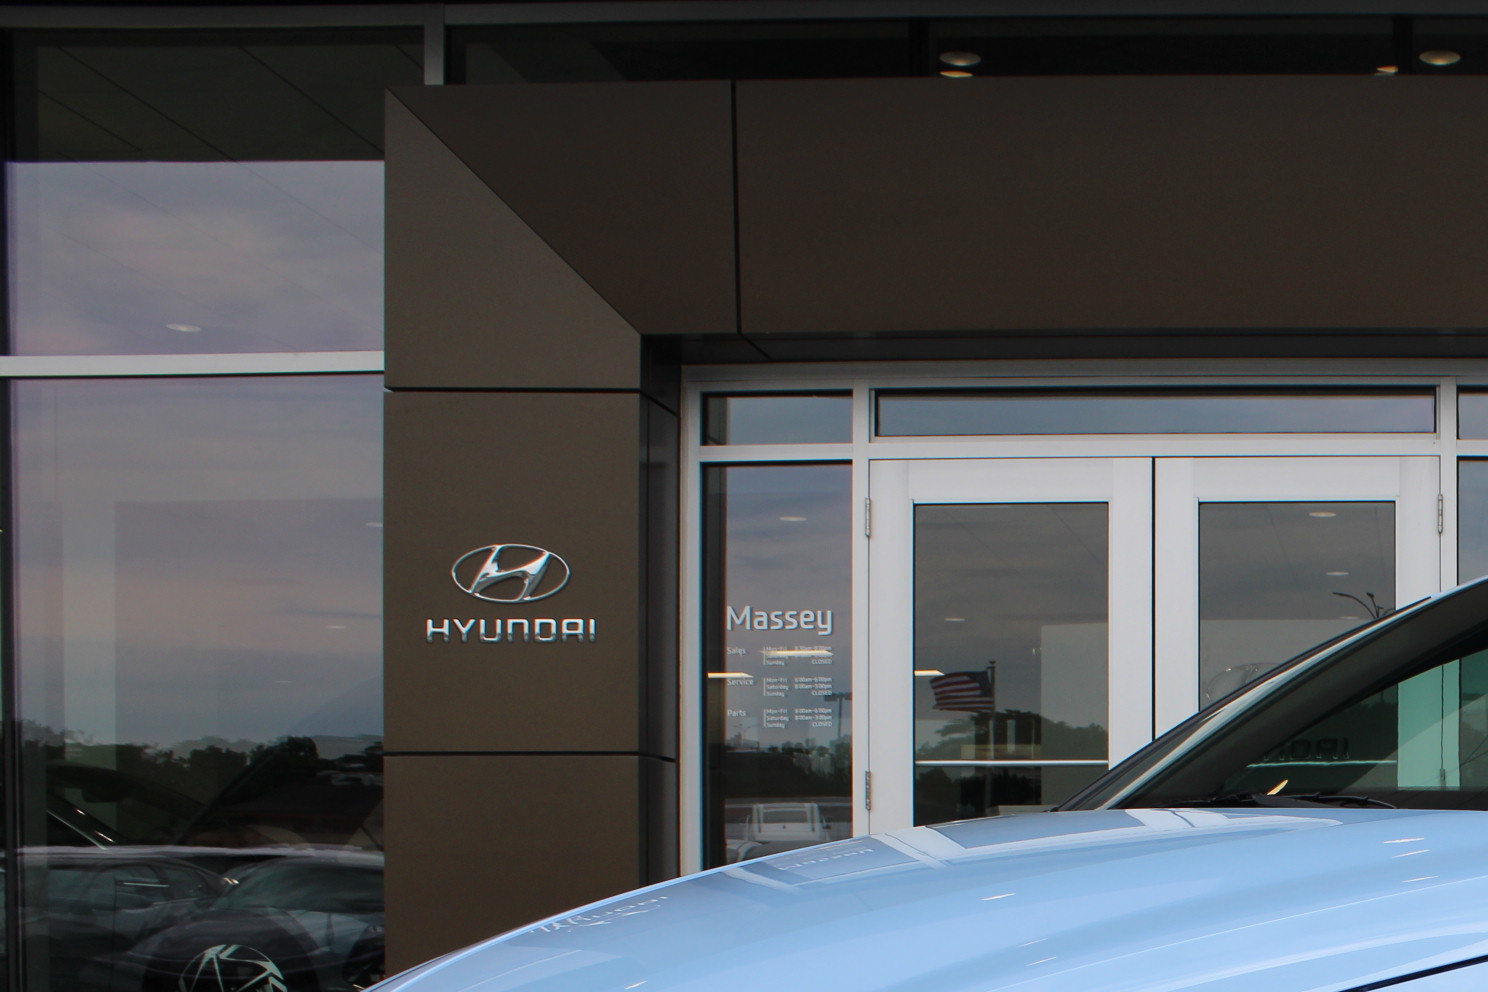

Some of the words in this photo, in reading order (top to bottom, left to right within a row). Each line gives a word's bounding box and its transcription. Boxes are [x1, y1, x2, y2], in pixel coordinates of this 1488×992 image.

[727, 606, 833, 635] Massey
[426, 618, 597, 643] HYUNDAI
[727, 647, 747, 656] Sales
[727, 678, 754, 686] Service
[727, 709, 747, 717] Parts
